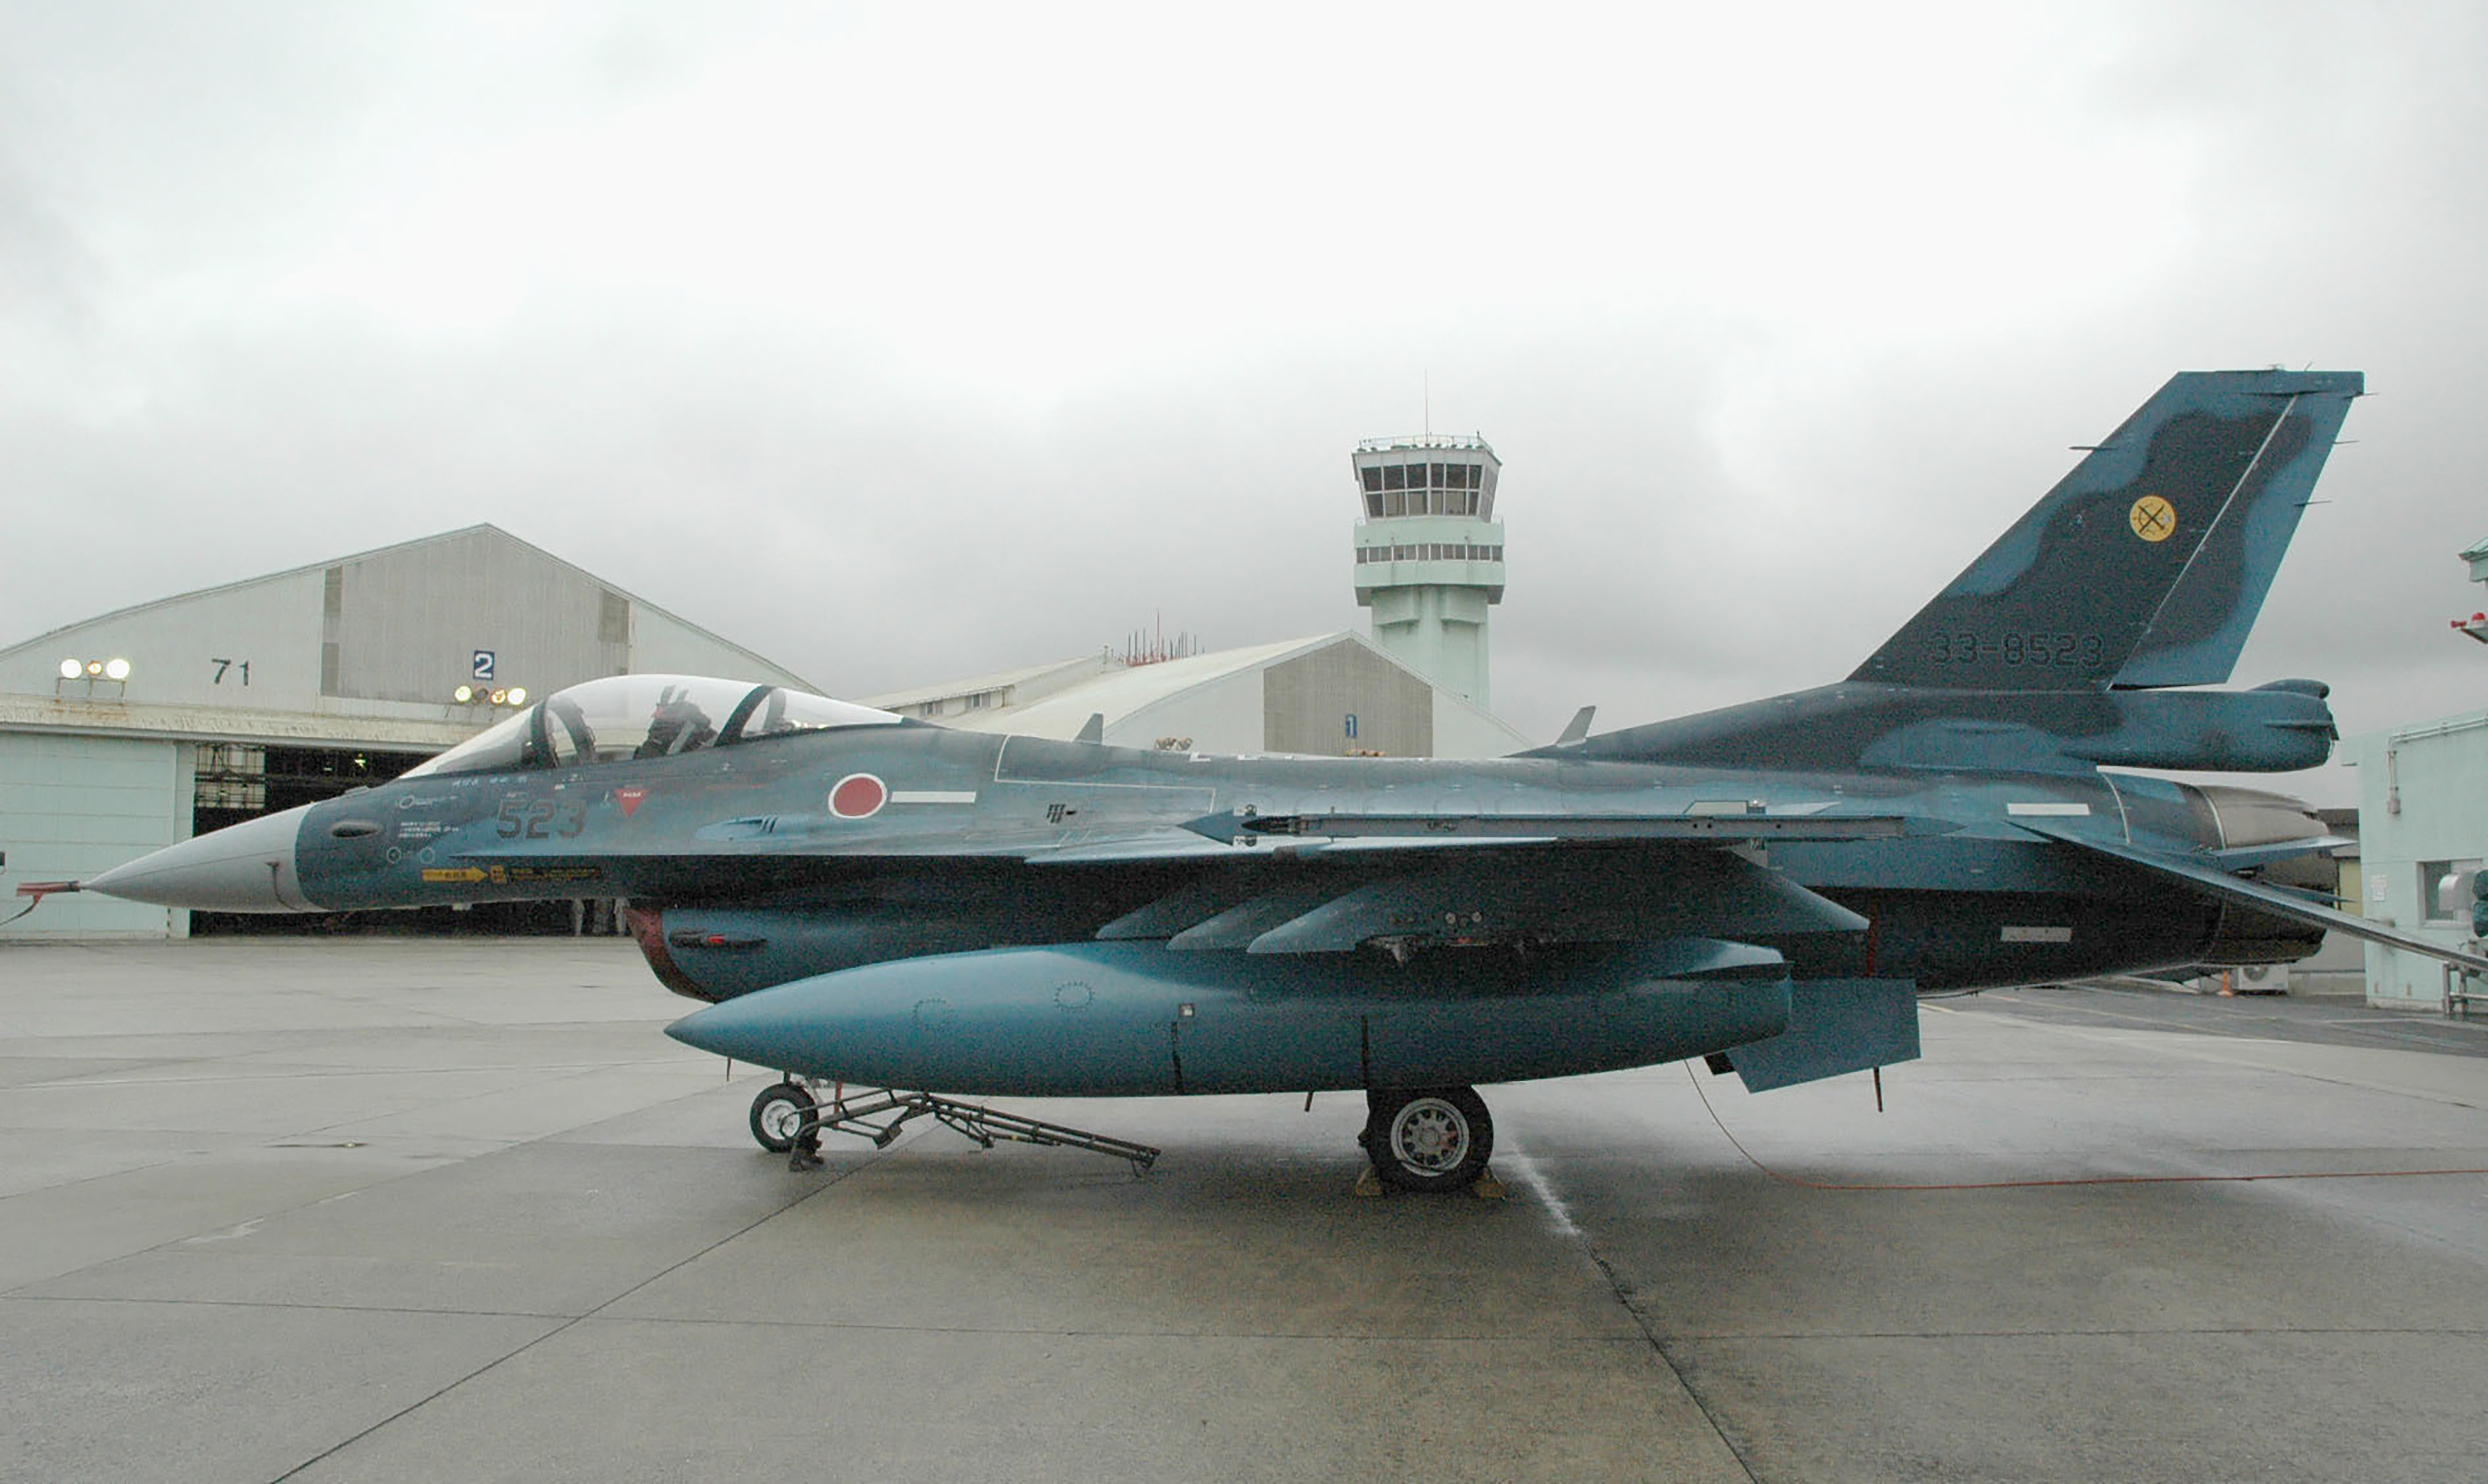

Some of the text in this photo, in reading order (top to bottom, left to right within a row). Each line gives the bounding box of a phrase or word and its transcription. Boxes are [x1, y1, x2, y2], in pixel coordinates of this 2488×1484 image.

[1929, 631, 2104, 667] 33-8523
[211, 659, 249, 685] 71
[475, 653, 493, 678] 2
[497, 799, 587, 840] 523
